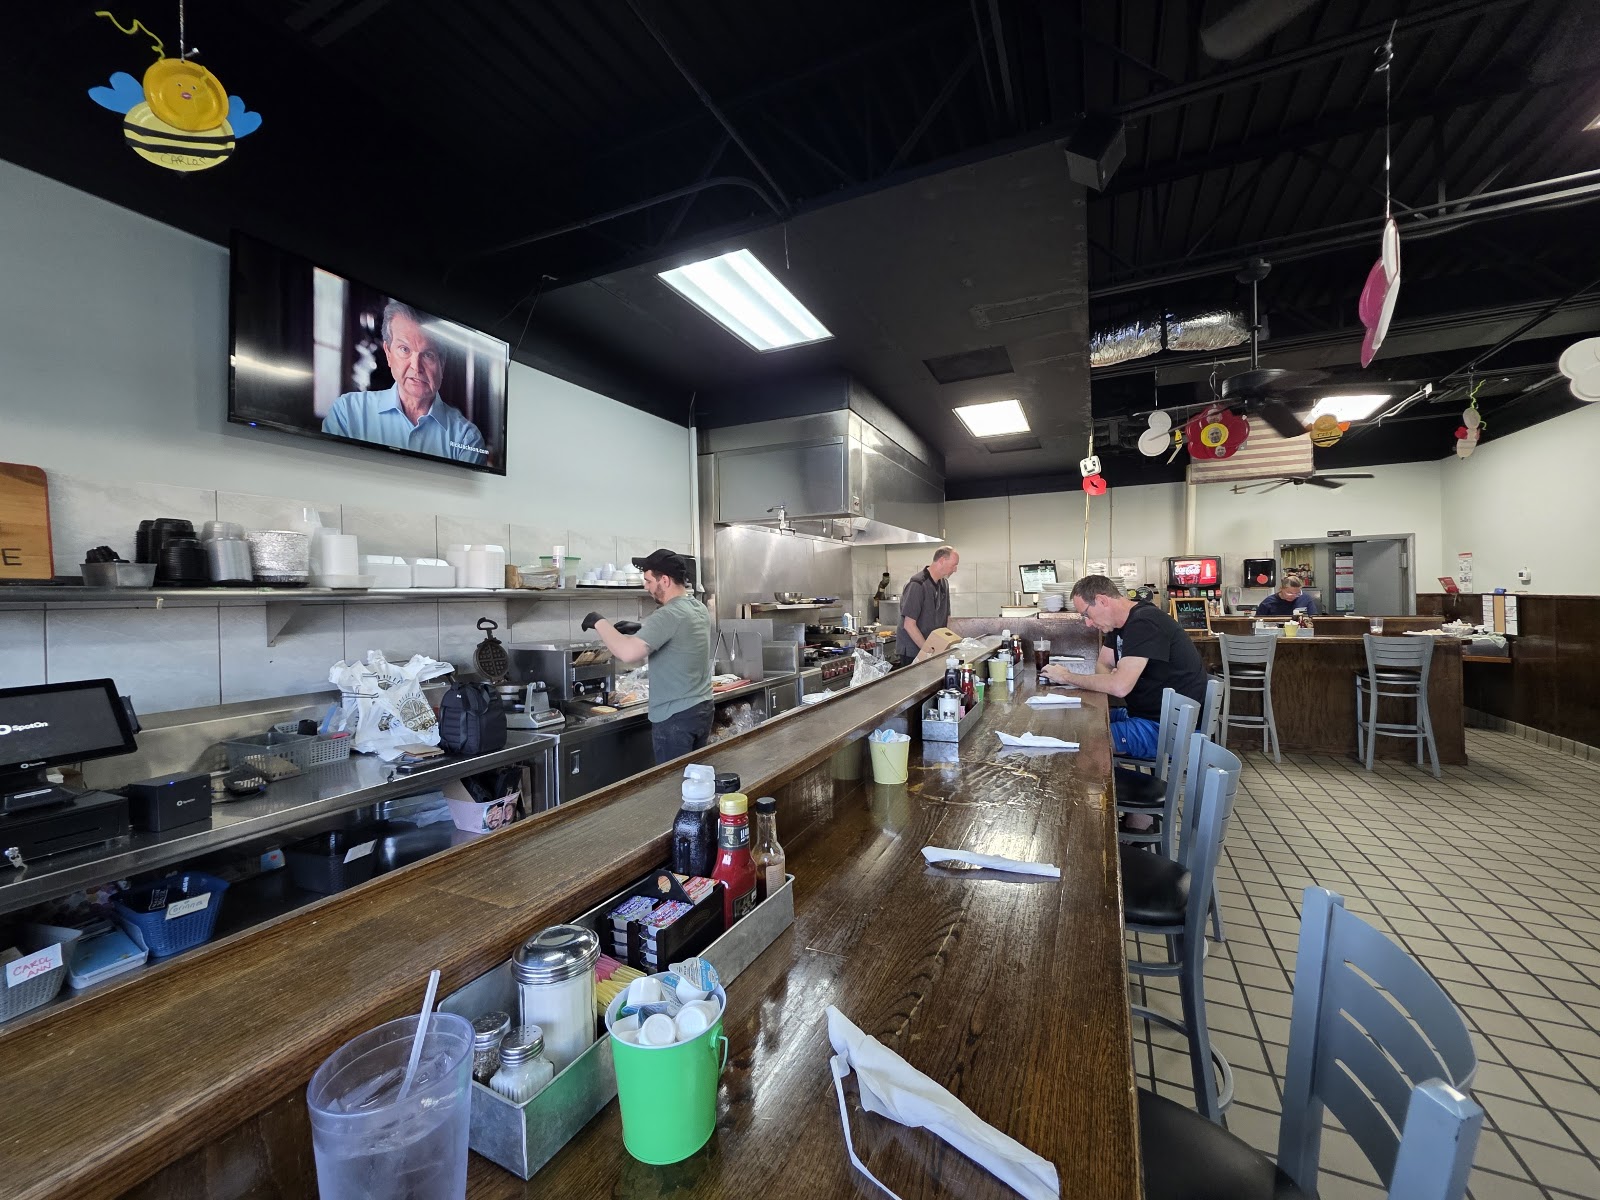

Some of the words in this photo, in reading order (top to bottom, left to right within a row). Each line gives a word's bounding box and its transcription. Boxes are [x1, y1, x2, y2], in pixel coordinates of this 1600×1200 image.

[12, 721, 49, 732] SpotOn
[13, 957, 53, 976] CAROL
[27, 962, 51, 978] ANN
